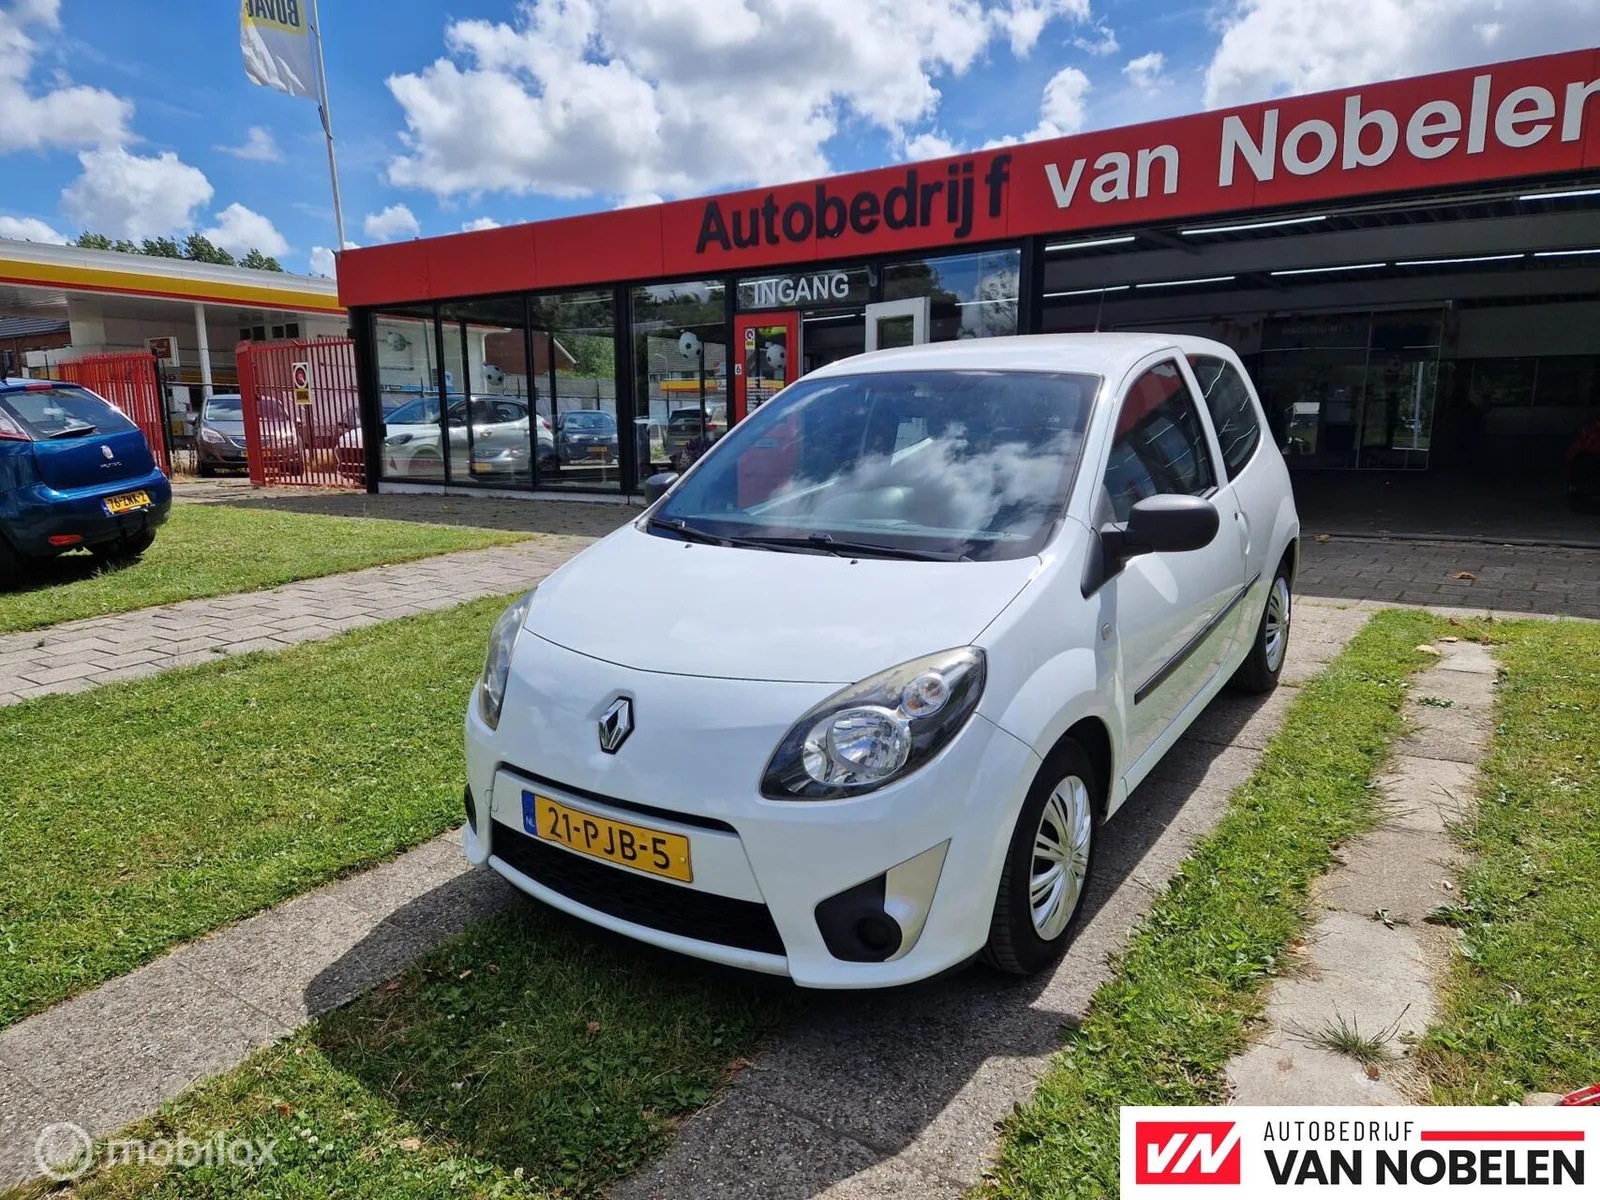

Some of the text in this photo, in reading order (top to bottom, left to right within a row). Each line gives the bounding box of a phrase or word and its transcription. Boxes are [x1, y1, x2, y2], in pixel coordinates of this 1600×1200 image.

[695, 154, 1012, 253] Autobedrijf
[1044, 144, 1179, 208] van
[754, 273, 849, 304] INGANG
[548, 807, 670, 869] 21-PJB-5
